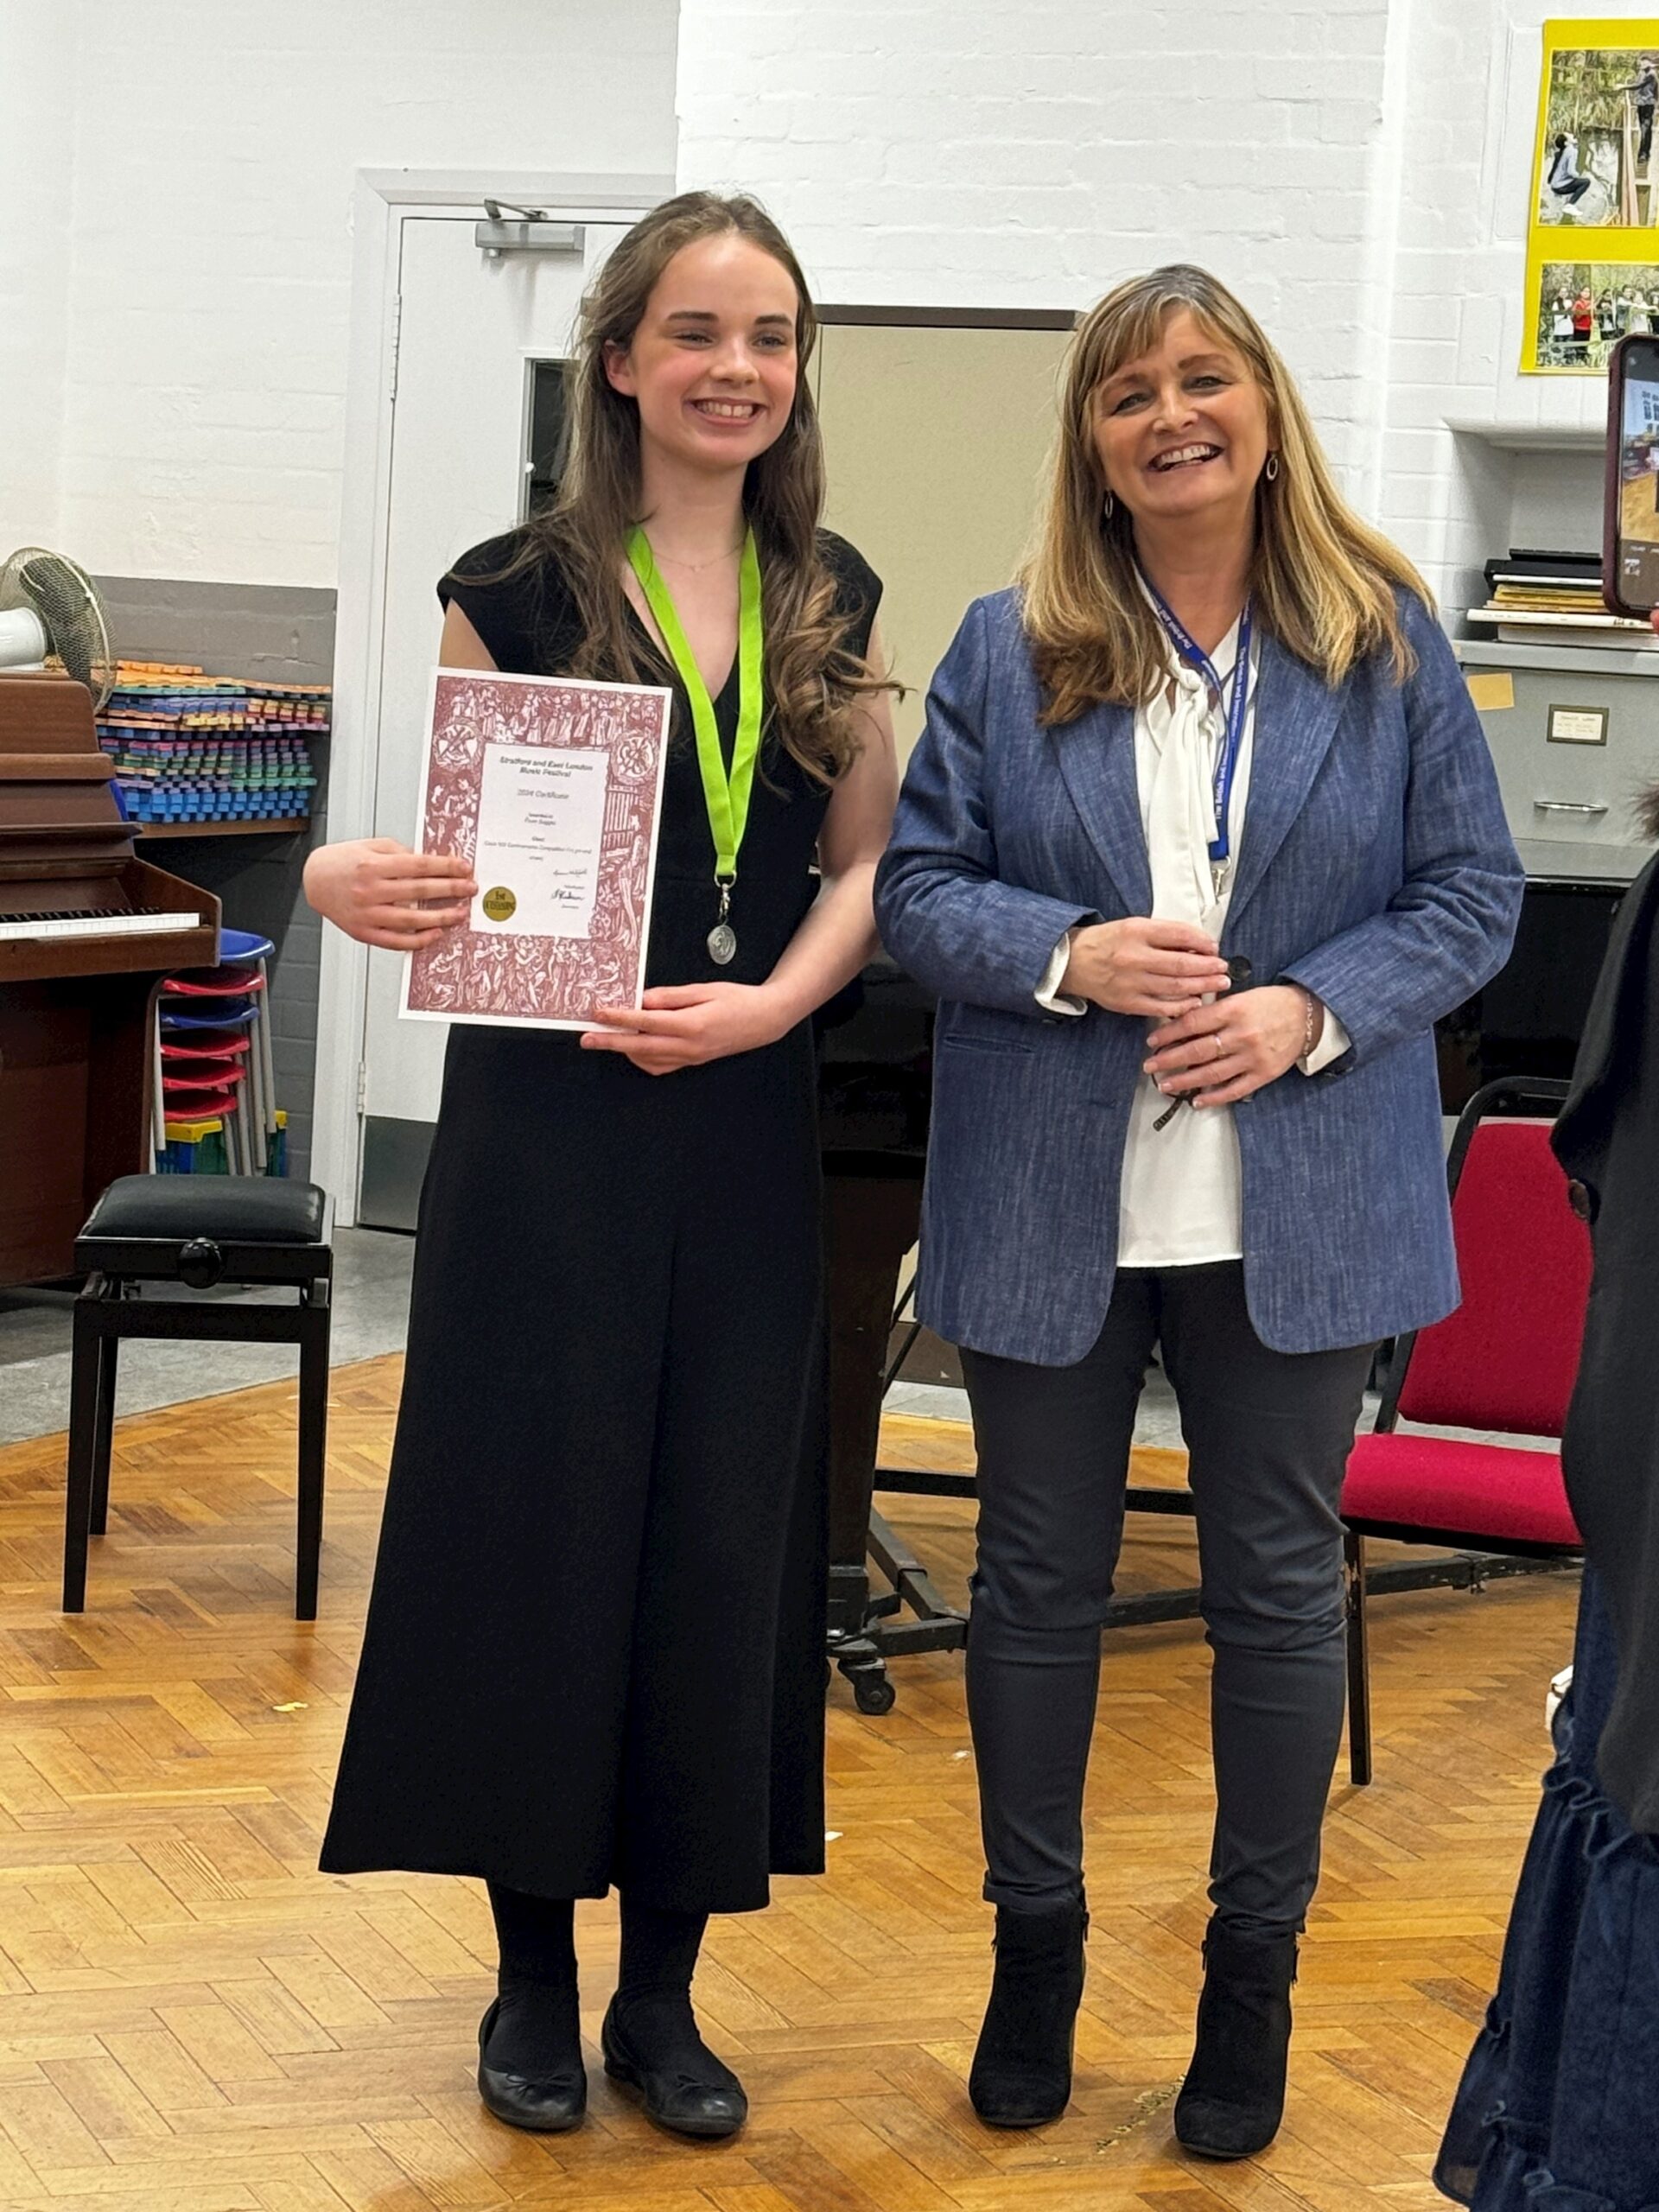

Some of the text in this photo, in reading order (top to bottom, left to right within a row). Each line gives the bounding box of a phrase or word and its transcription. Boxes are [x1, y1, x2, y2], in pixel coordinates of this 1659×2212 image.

[519, 766, 571, 778] Music Festival
[565, 762, 594, 771] London
[1215, 780, 1224, 804] British
